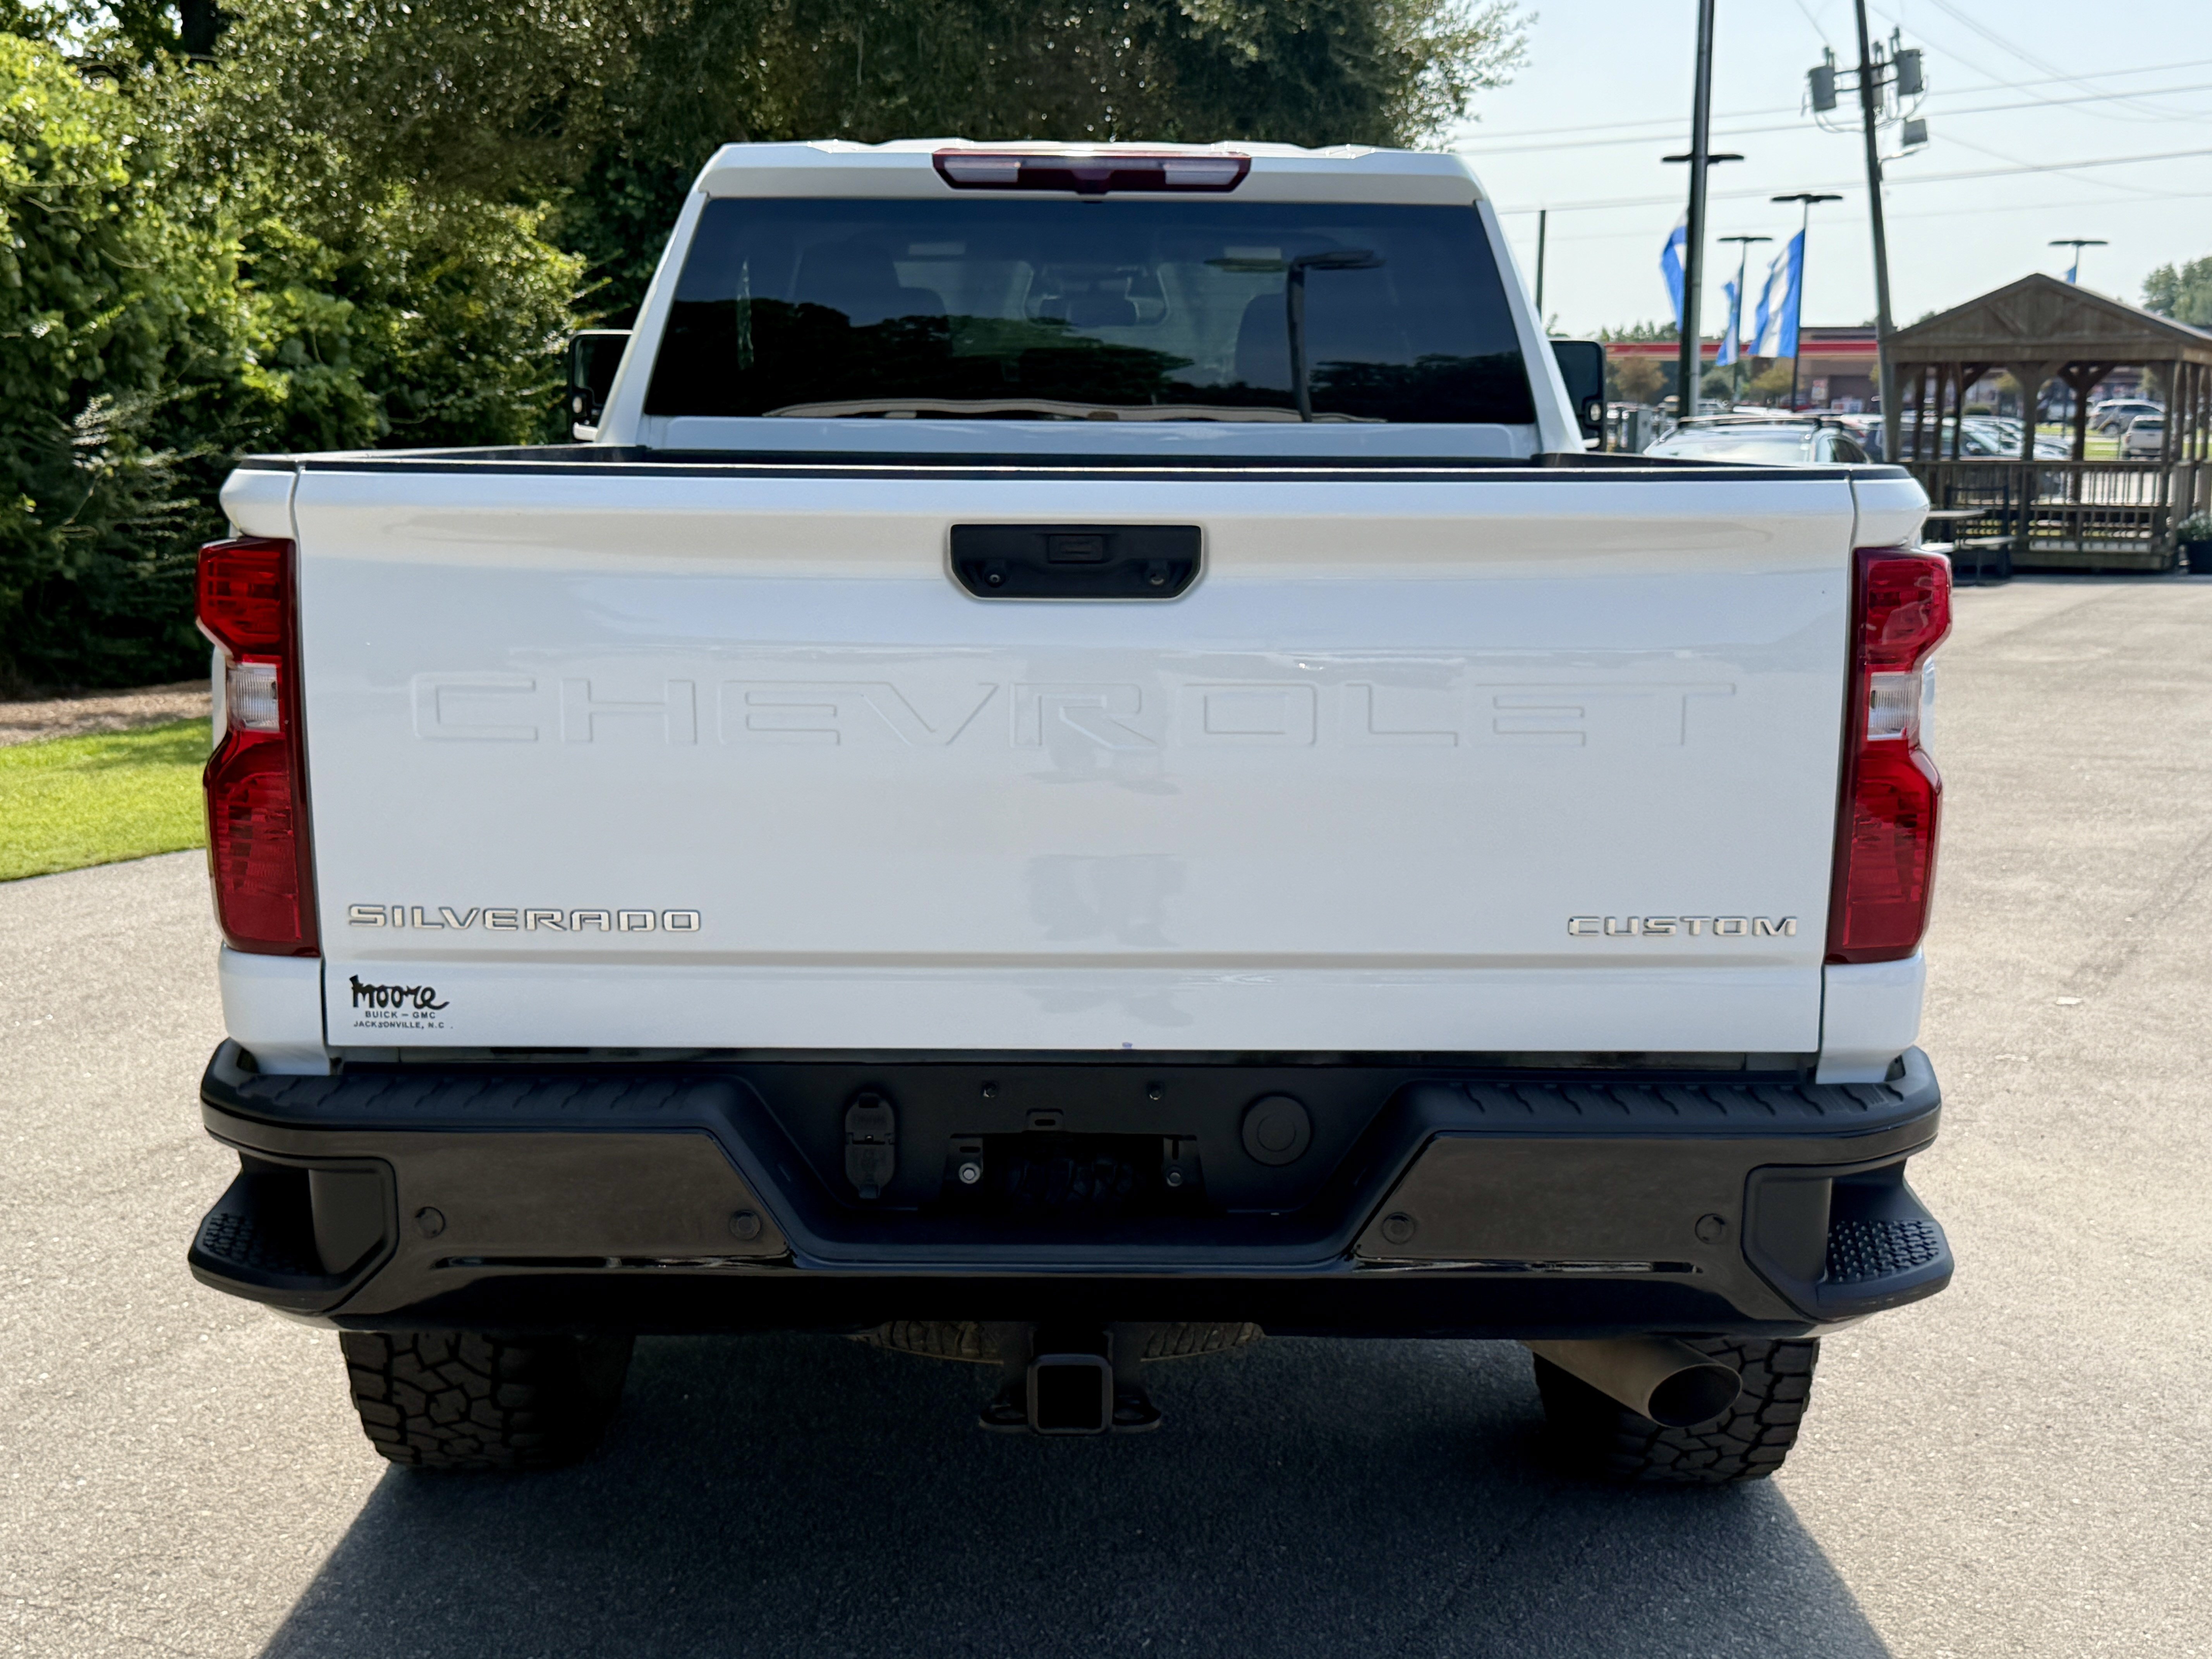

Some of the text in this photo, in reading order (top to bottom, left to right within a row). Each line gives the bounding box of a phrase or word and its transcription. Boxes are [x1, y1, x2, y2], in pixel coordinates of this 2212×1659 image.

[410, 672, 1736, 748] CHEVROLET
[348, 903, 701, 931] SILVERADO
[1567, 915, 1798, 936] CUSTOM
[353, 1020, 424, 1029] JACKSONVILLE,
